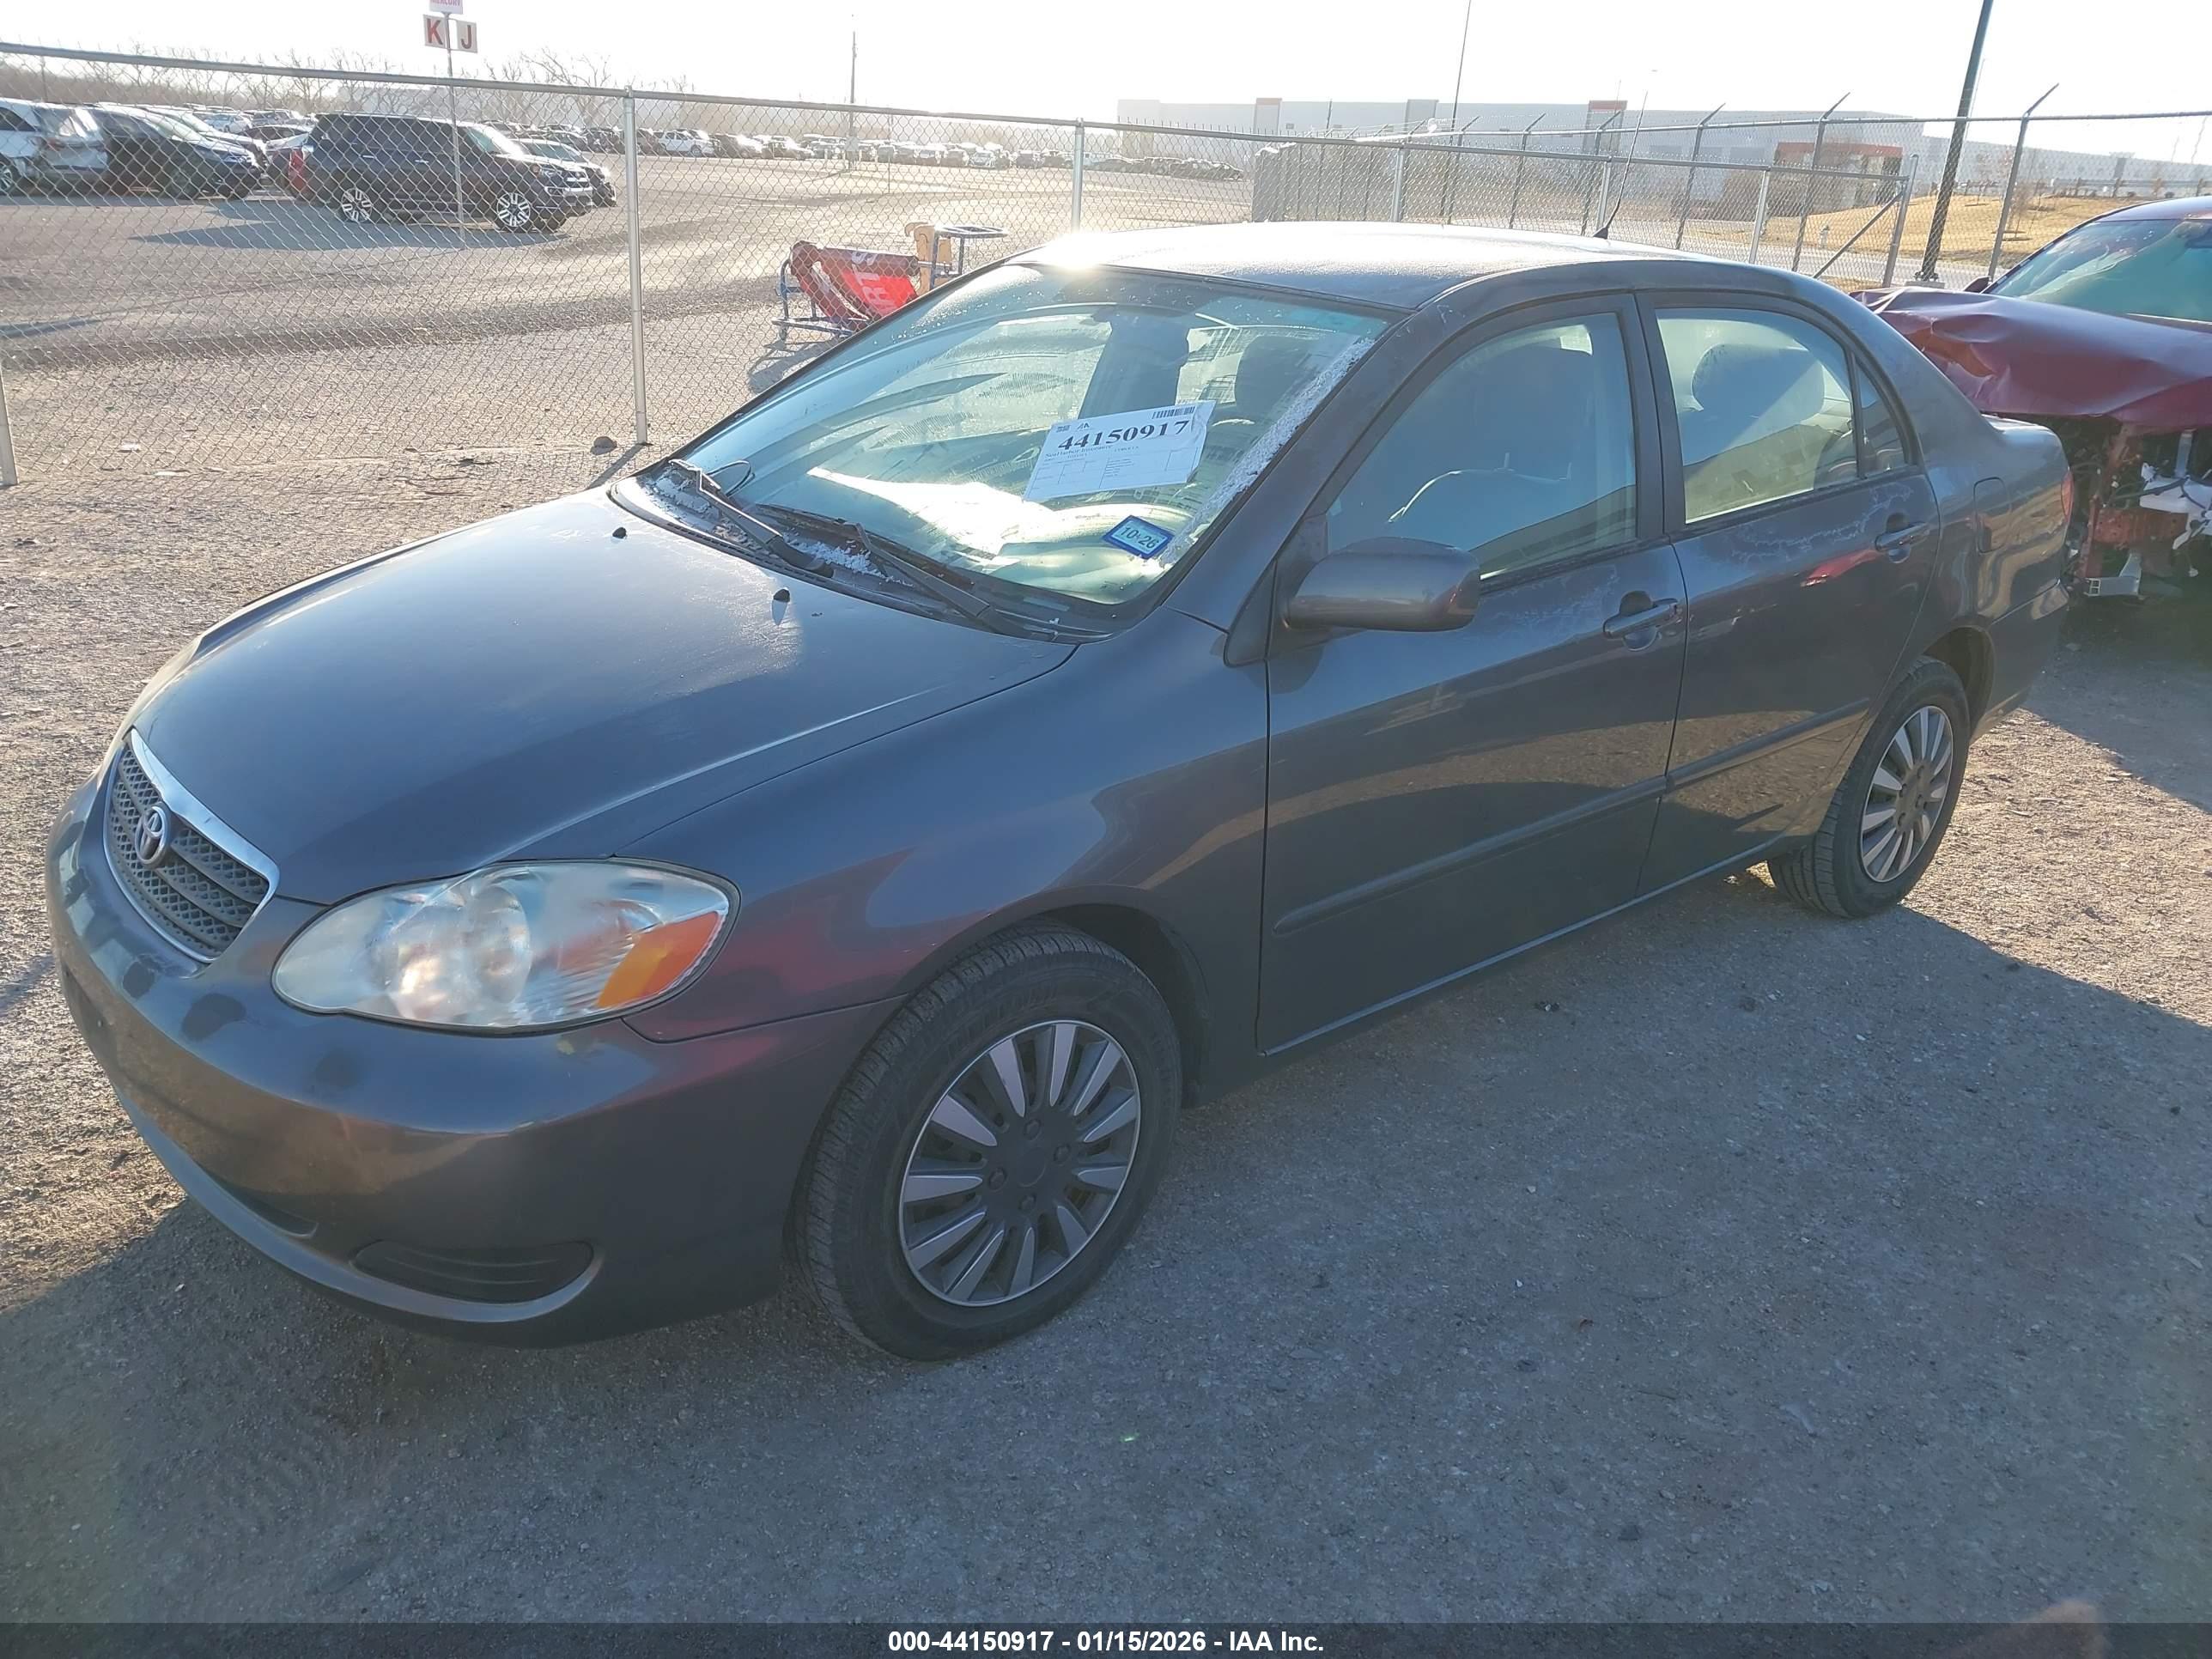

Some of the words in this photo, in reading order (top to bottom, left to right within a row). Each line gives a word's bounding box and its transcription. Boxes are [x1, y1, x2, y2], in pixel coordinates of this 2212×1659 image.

[427, 18, 443, 45] K
[460, 25, 471, 49] J
[1058, 420, 1190, 451] 44150917
